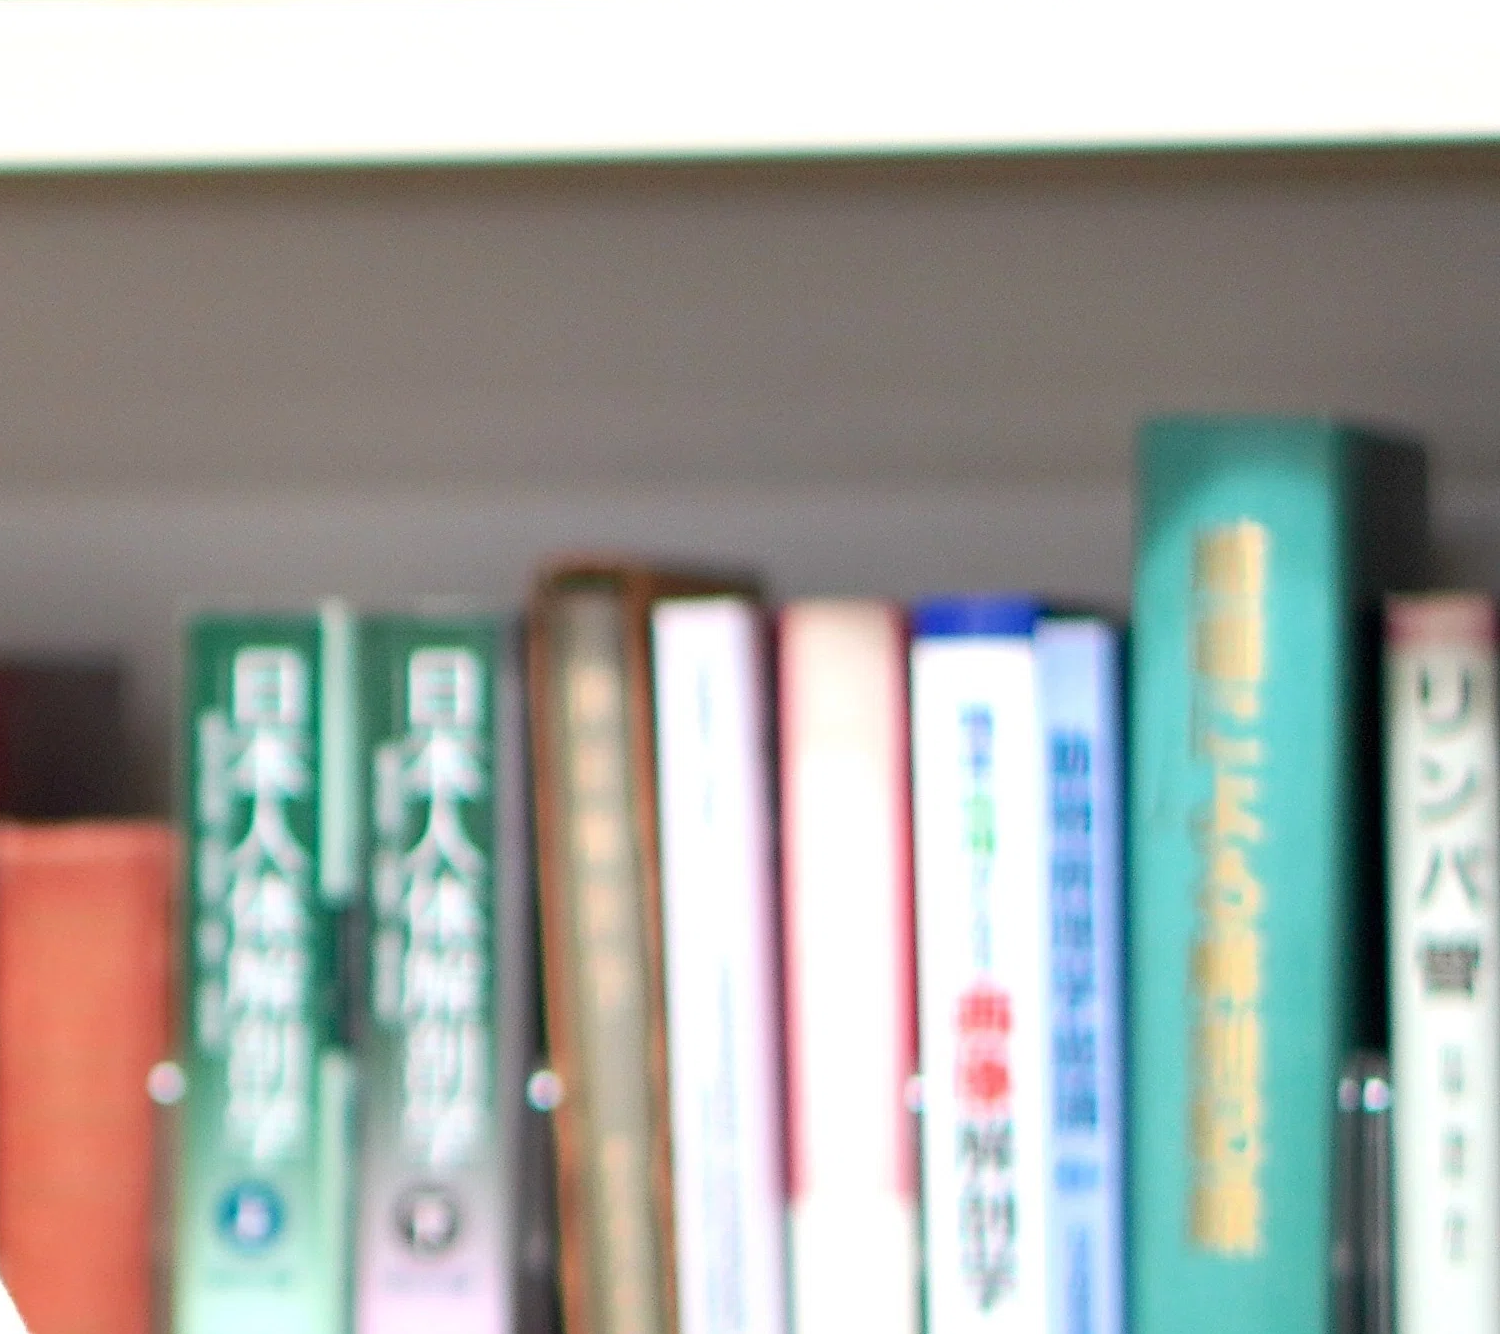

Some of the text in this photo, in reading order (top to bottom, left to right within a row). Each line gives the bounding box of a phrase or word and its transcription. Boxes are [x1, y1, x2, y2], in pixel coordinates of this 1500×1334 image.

[224, 643, 304, 1167] 日本人体解剖学
[400, 643, 482, 1169] 日本人体解剖学
[1414, 665, 1484, 999] リンパ管
